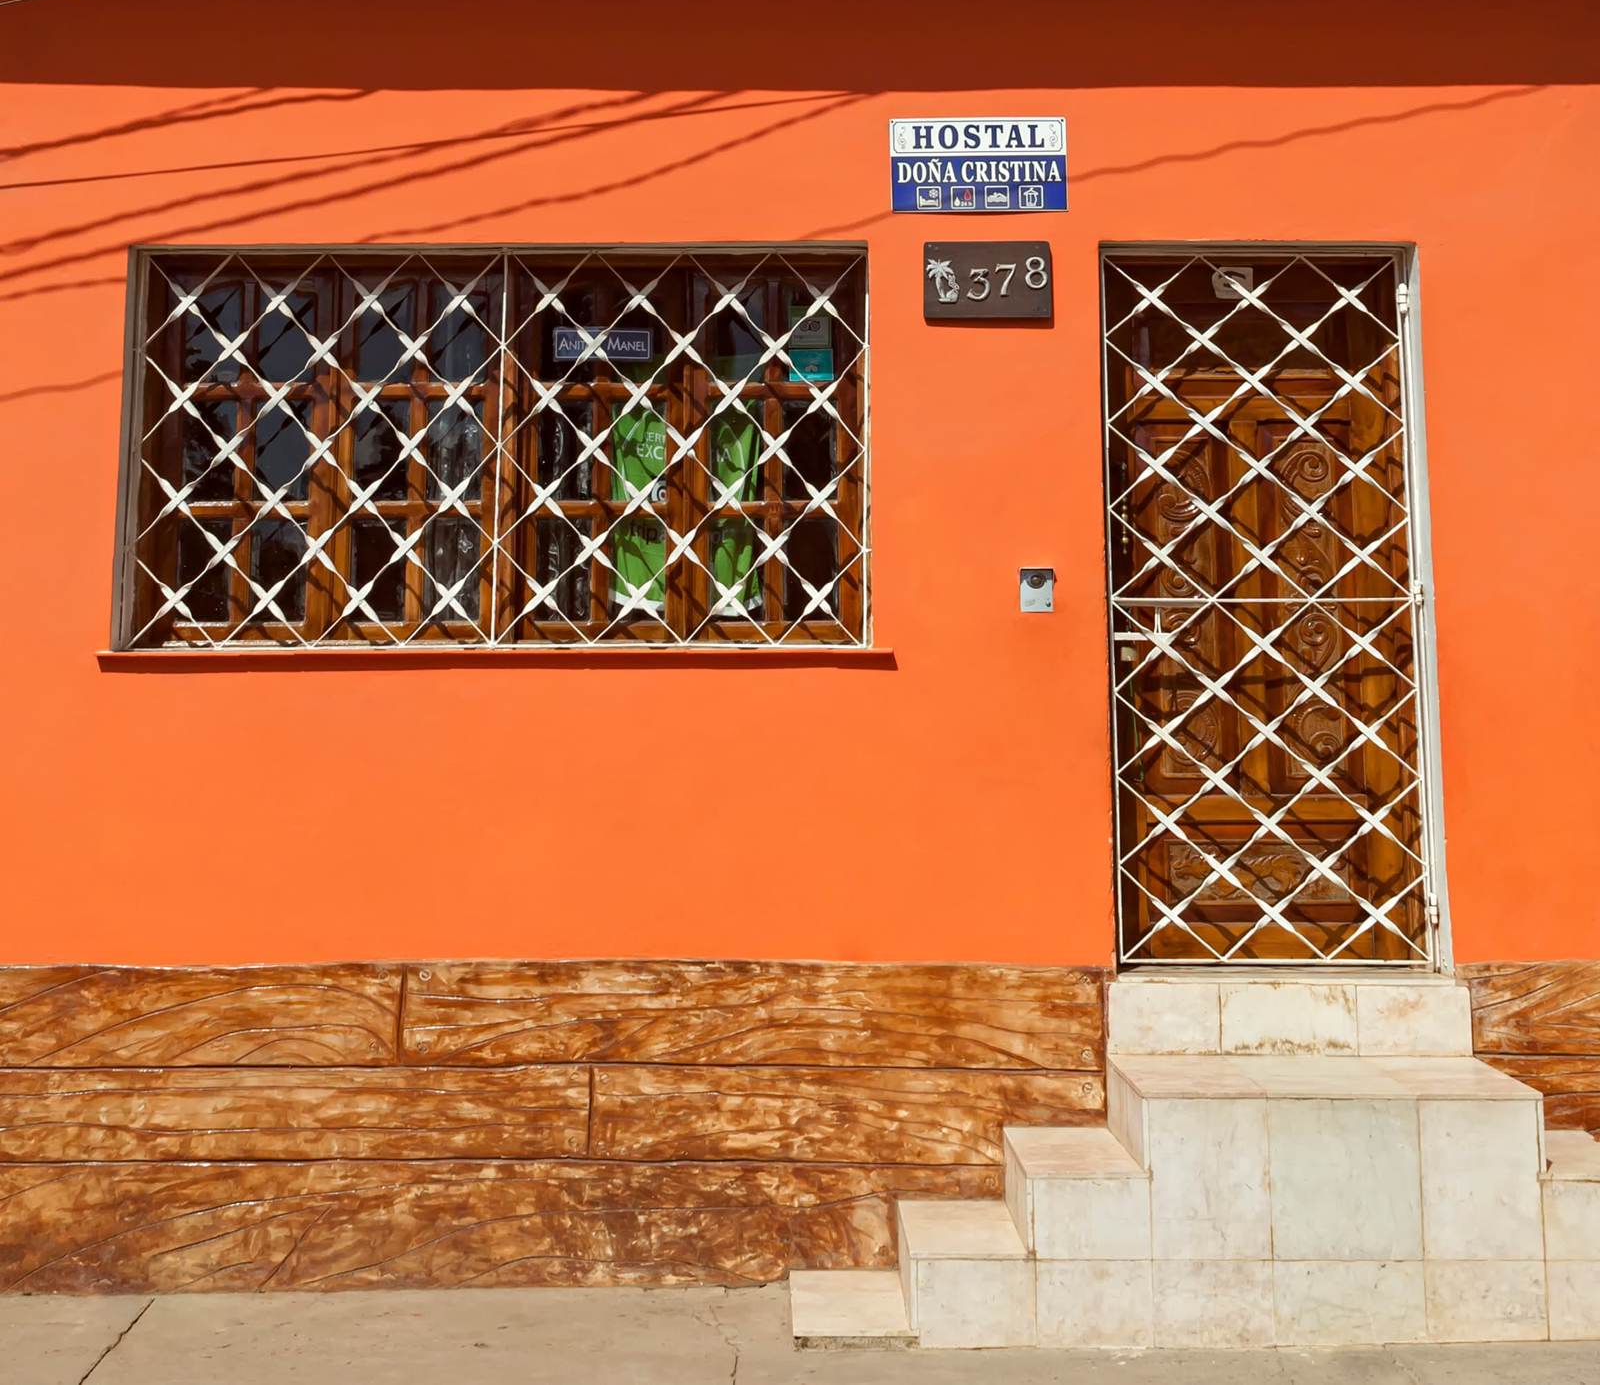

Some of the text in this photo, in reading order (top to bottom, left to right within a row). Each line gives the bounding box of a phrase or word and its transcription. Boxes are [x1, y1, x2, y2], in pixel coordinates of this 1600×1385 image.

[912, 124, 1045, 149] HOSTAL
[897, 158, 1062, 183] DOÑA CRISTINA
[966, 256, 1048, 301] 378
[607, 337, 647, 352] MANEL
